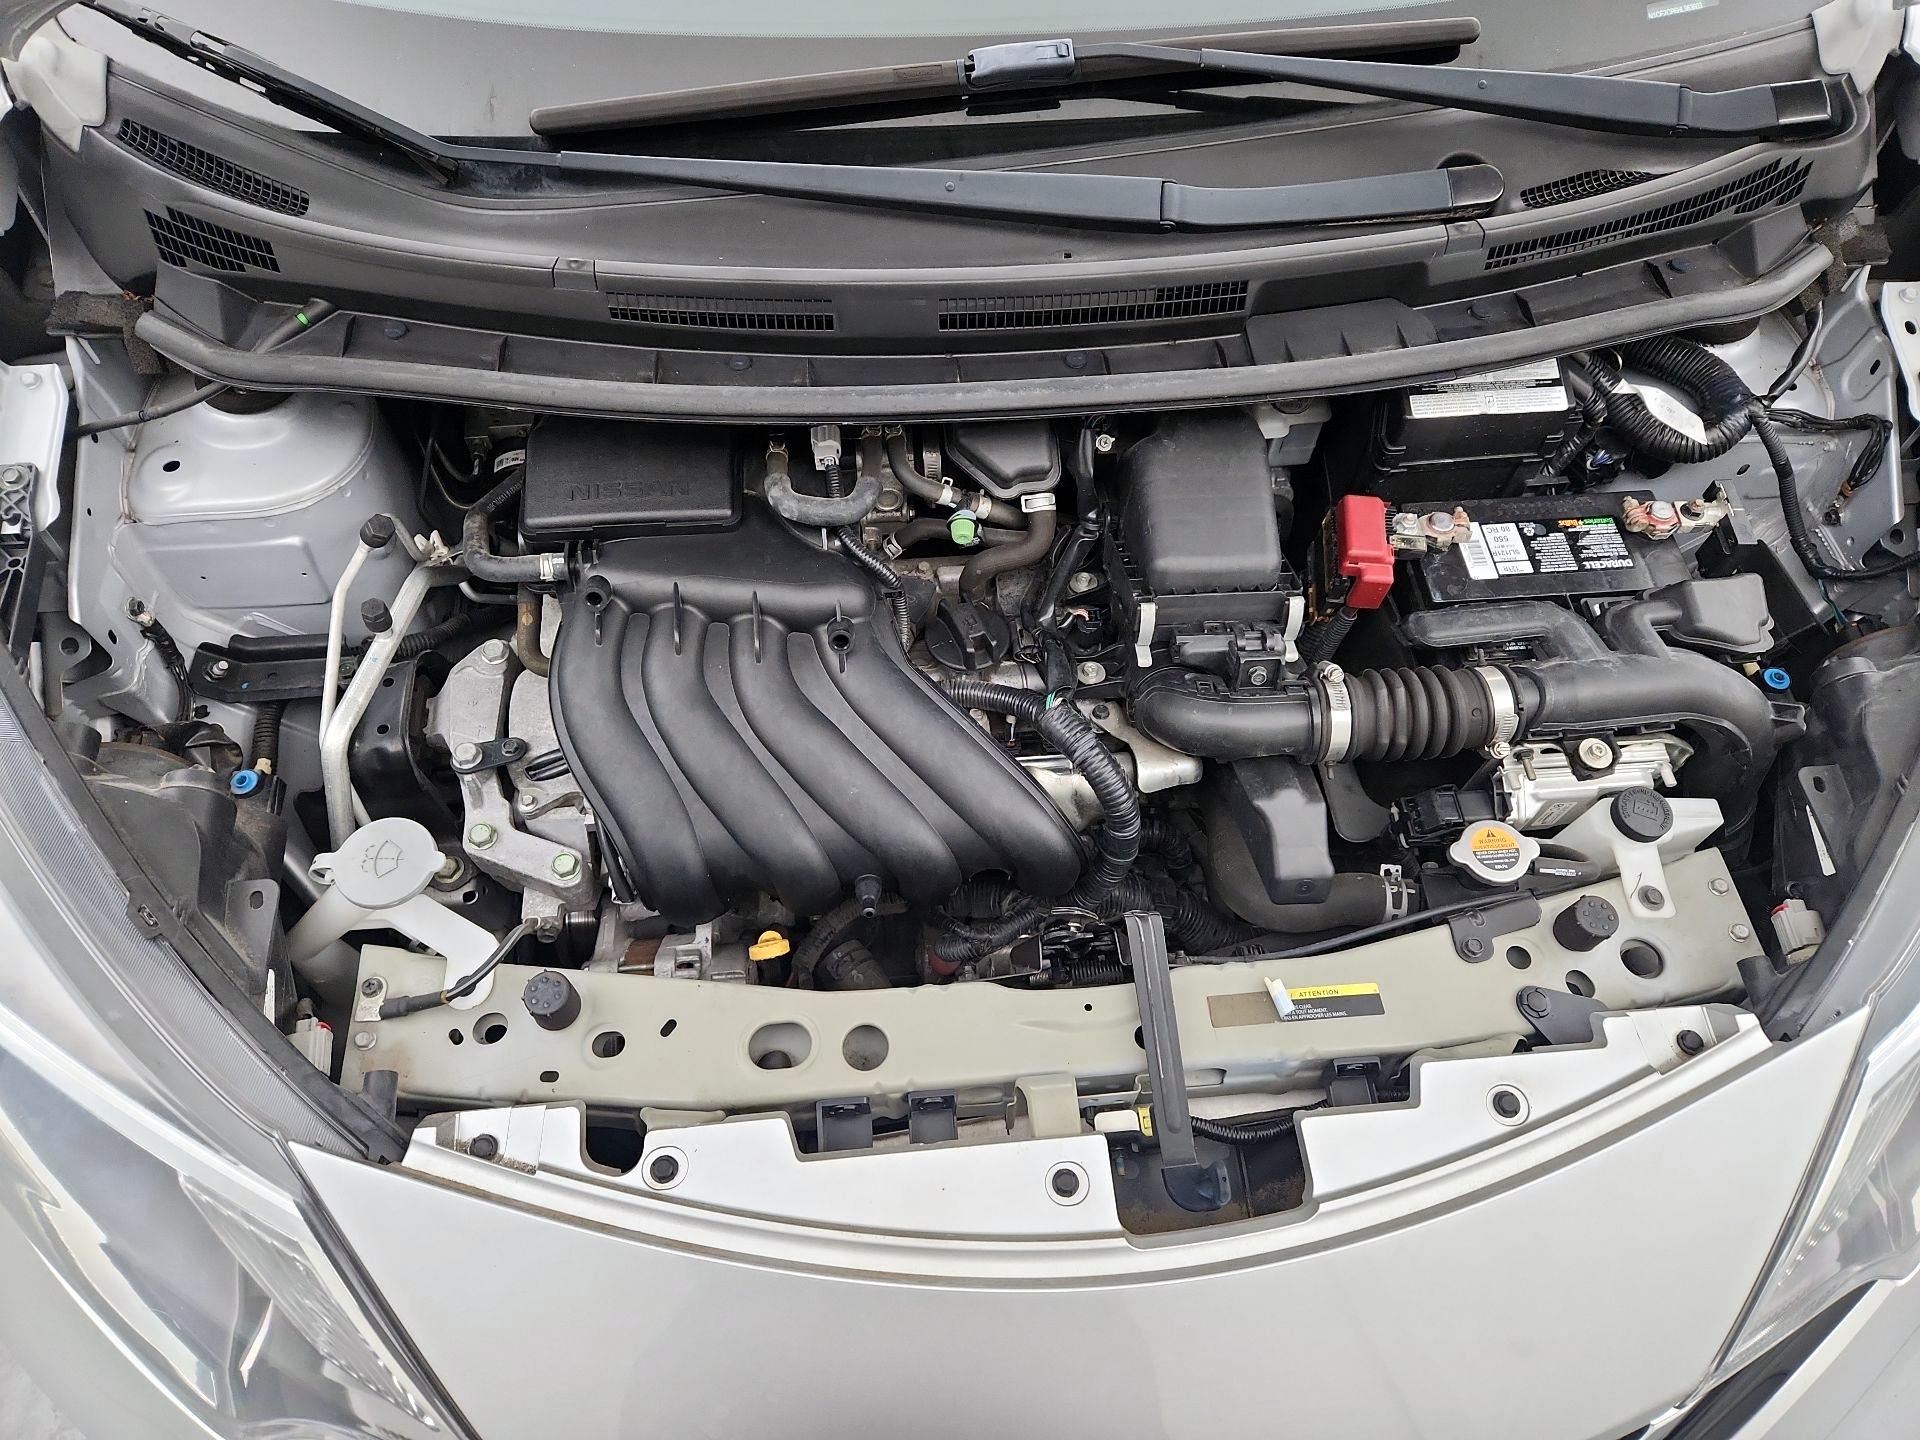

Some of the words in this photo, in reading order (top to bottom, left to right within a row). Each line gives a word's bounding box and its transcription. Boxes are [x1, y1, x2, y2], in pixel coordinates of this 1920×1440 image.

[569, 478, 690, 502] NISSAN
[1581, 559, 1634, 569] DURACELL
[1298, 989, 1339, 998] ATTENTION
